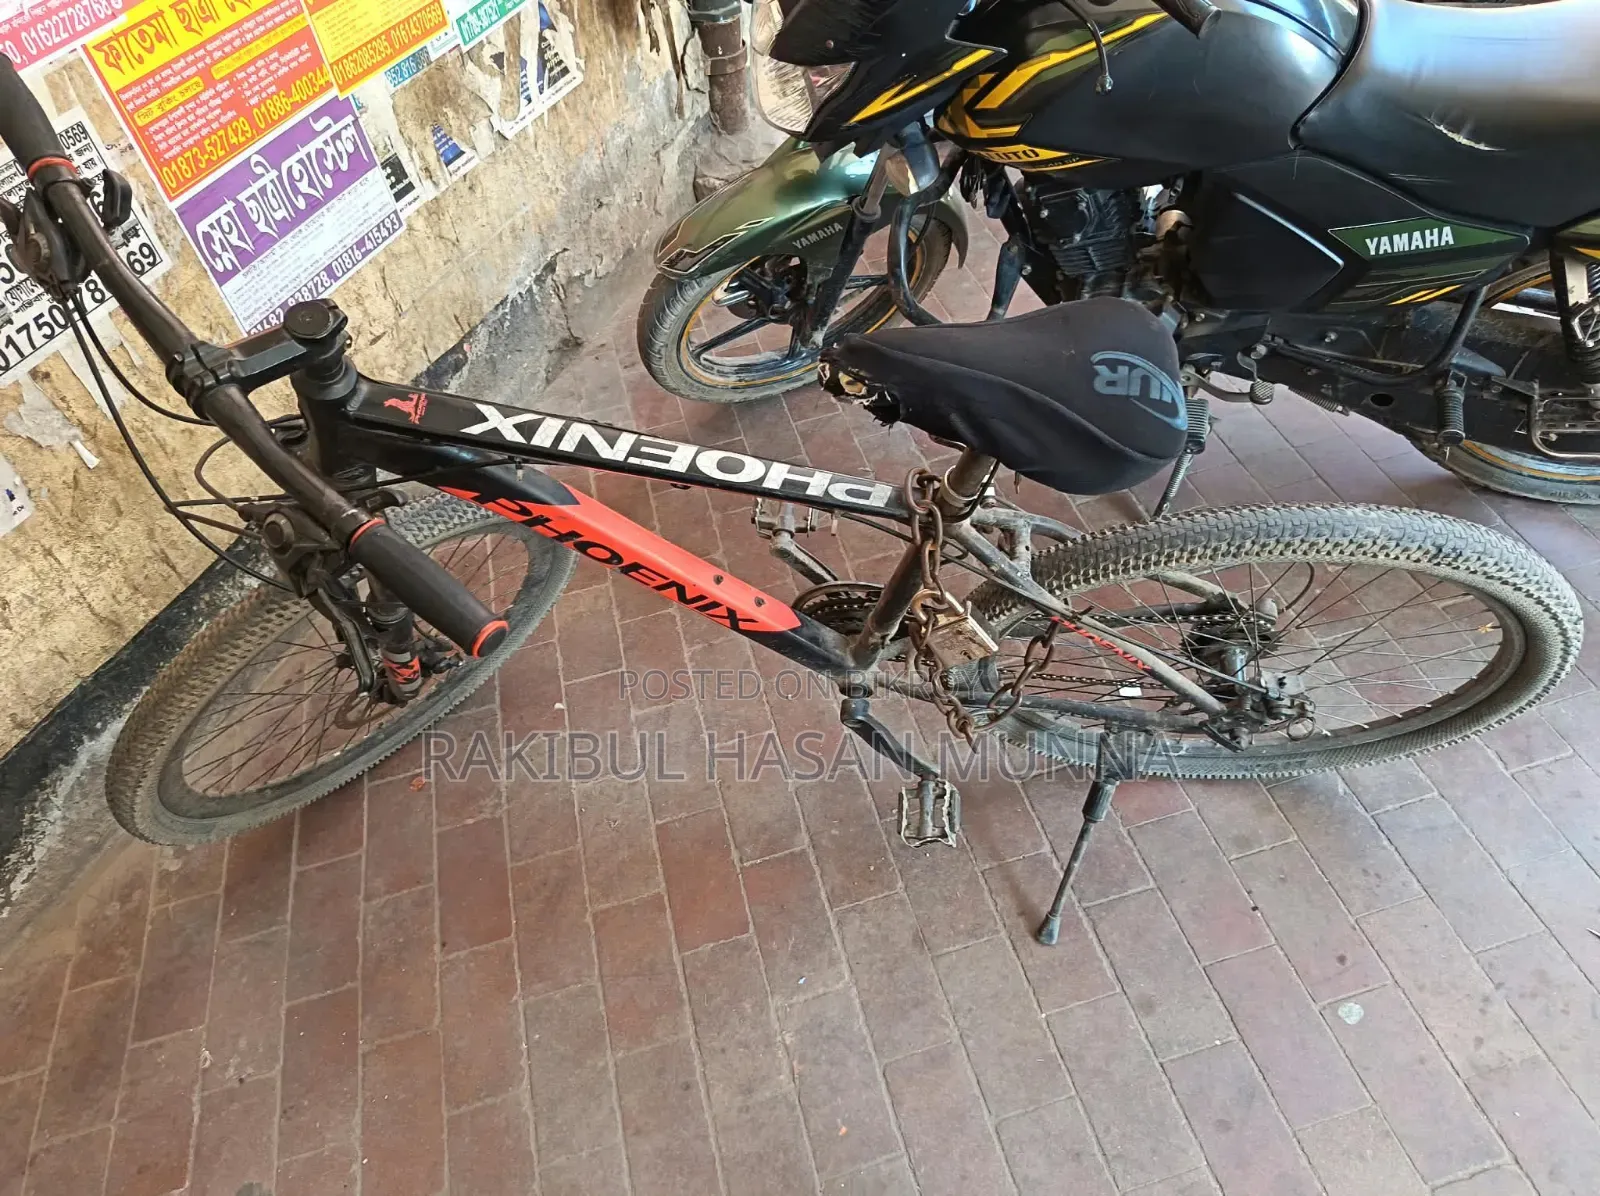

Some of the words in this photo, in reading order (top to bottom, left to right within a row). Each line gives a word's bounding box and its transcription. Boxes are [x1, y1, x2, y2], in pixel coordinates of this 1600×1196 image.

[92, 4, 180, 76] ফাতেমা
[332, 37, 394, 87] 01862085295,
[162, 117, 257, 189] 01873-527429,
[253, 66, 331, 129] 01886-400344
[237, 153, 297, 239] ছাত্রী
[281, 114, 369, 210] হোস্টেল
[332, 215, 400, 277] 01816-415493
[792, 221, 844, 250] YAMAHA
[1364, 226, 1455, 256] YAMAHA
[461, 402, 892, 508] PHOENIX
[480, 495, 760, 632] PHOENIX
